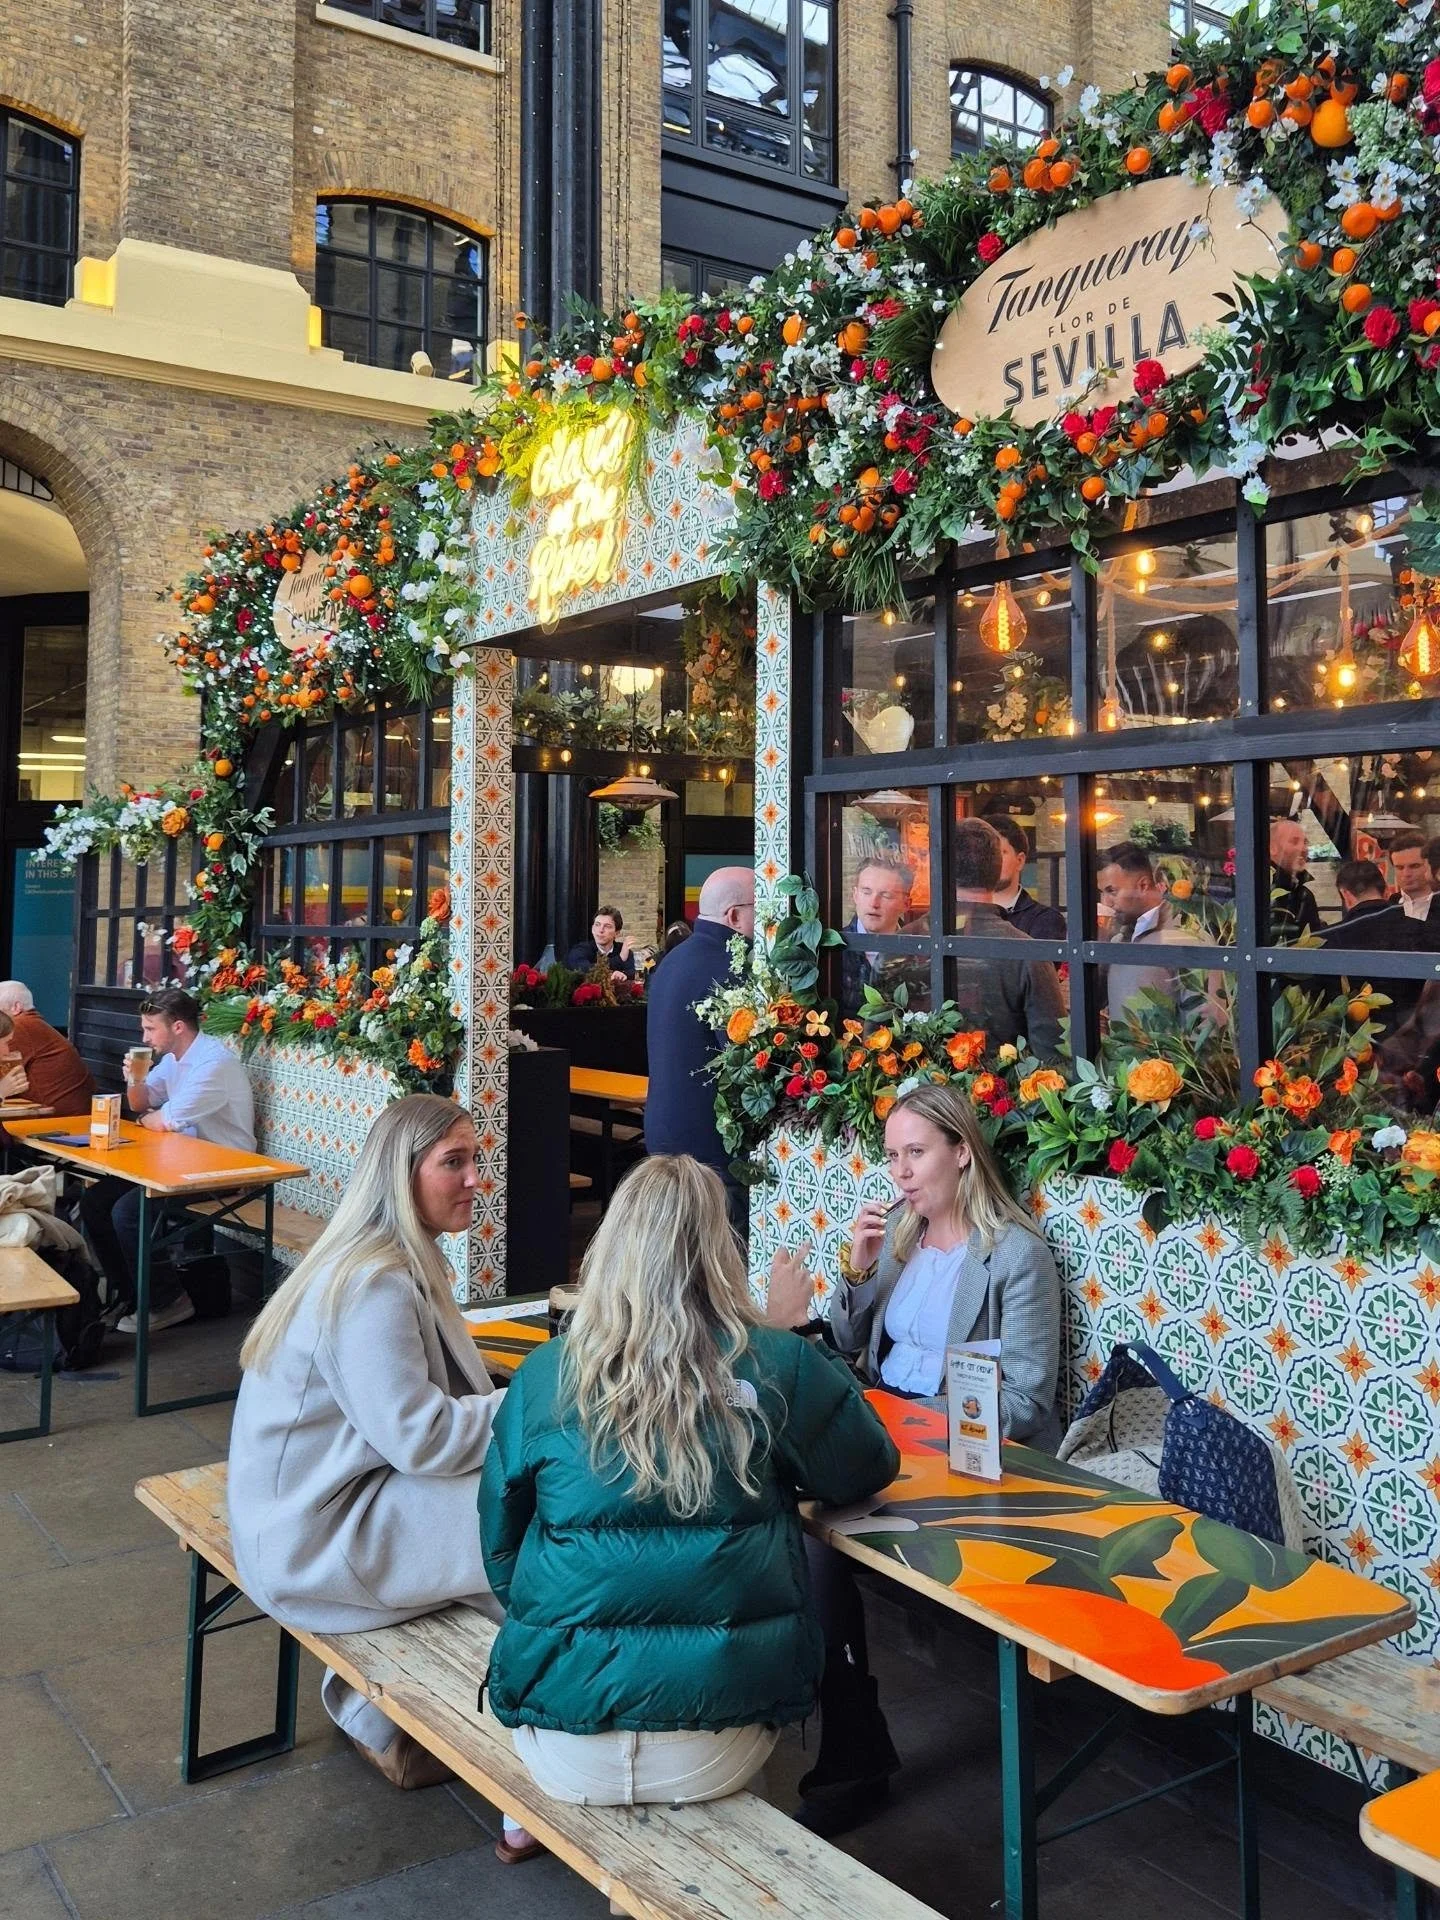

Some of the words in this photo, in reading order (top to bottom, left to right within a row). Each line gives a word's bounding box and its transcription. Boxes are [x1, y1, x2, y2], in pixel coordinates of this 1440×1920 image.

[988, 215, 1202, 334] Tanqueray
[1003, 300, 1189, 408] SEVILLA
[1048, 311, 1095, 338] FLOR
[1108, 297, 1131, 316] DE
[25, 869, 36, 879] IN
[38, 869, 58, 878] THIS
